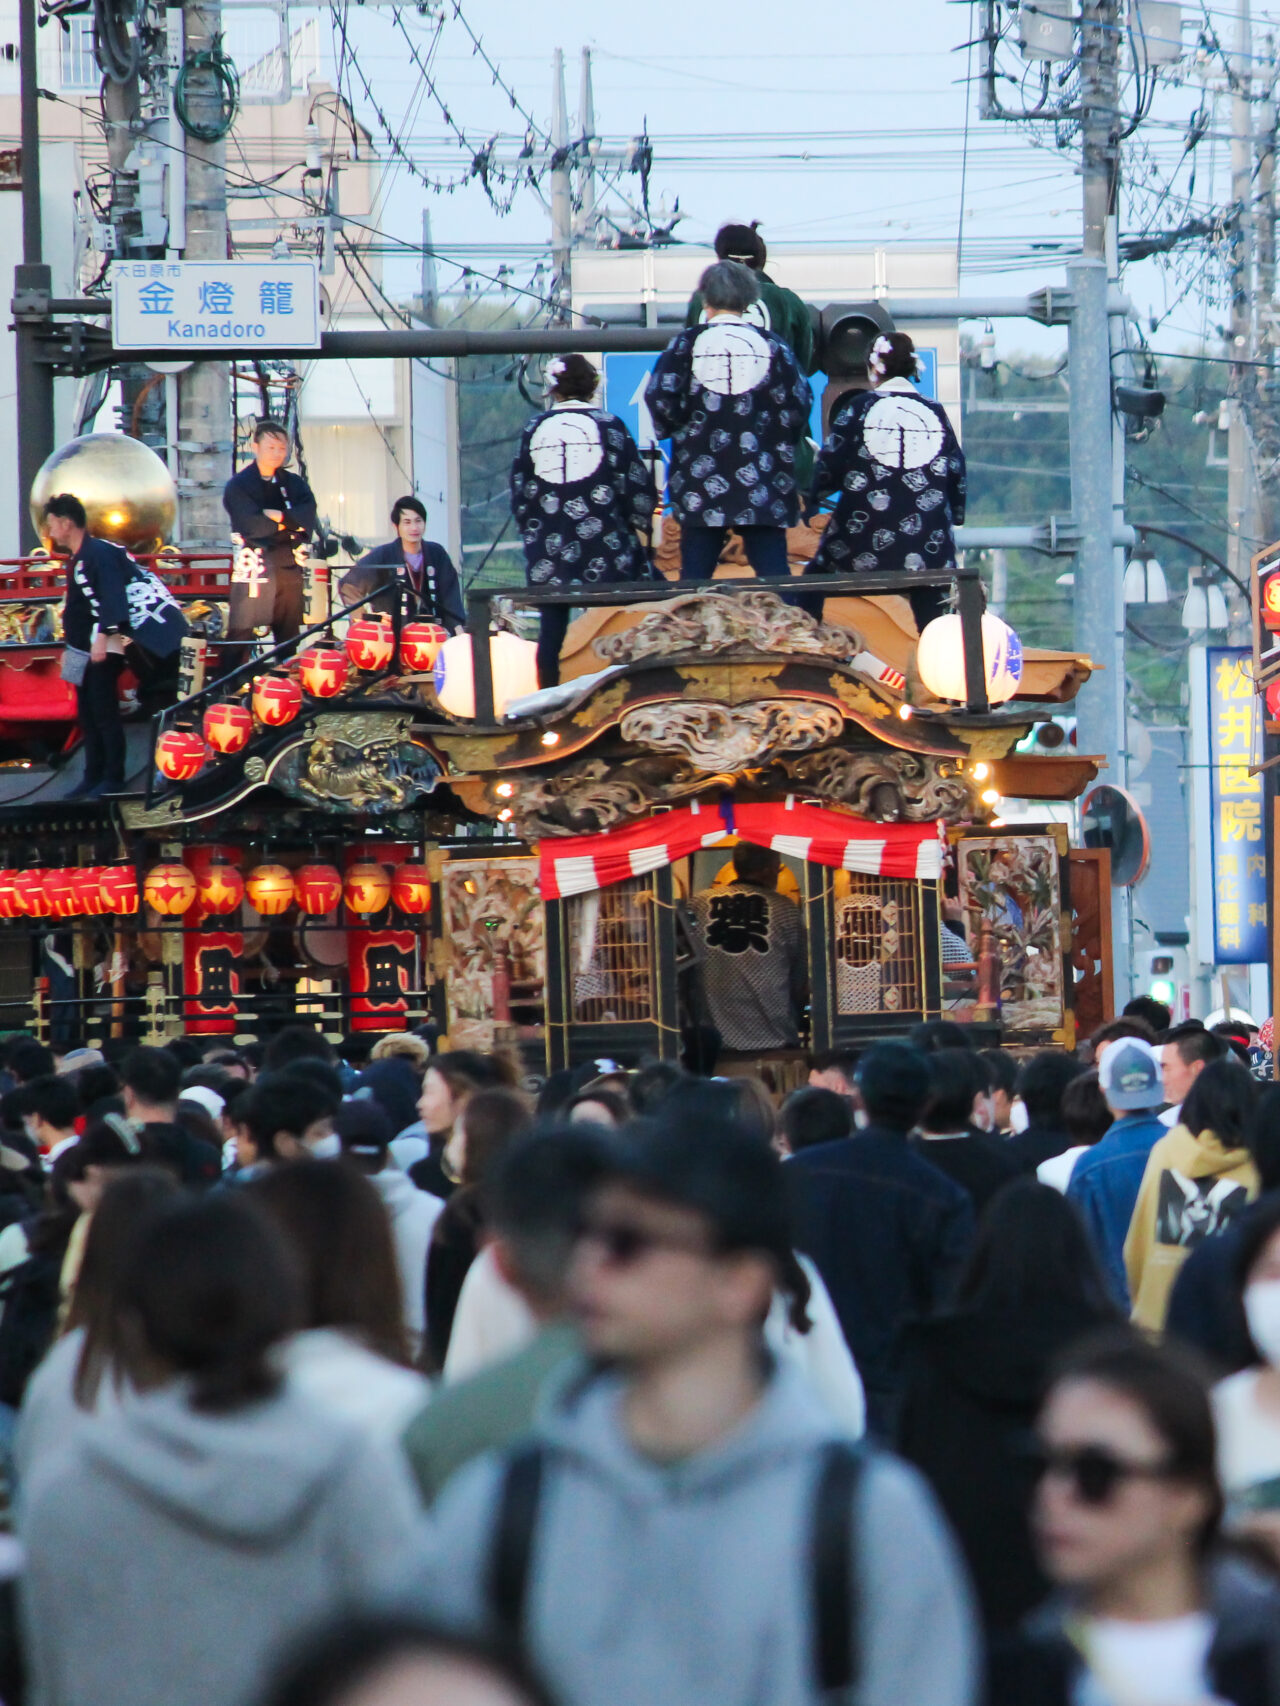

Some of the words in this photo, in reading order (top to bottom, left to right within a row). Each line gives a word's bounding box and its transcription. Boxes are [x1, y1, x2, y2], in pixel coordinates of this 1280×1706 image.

[115, 264, 182, 278] 大田原市
[138, 280, 294, 315] 金燈籠
[167, 319, 266, 338] Kanadoro
[1216, 657, 1262, 843] 松井医院
[1247, 853, 1268, 928] 内科
